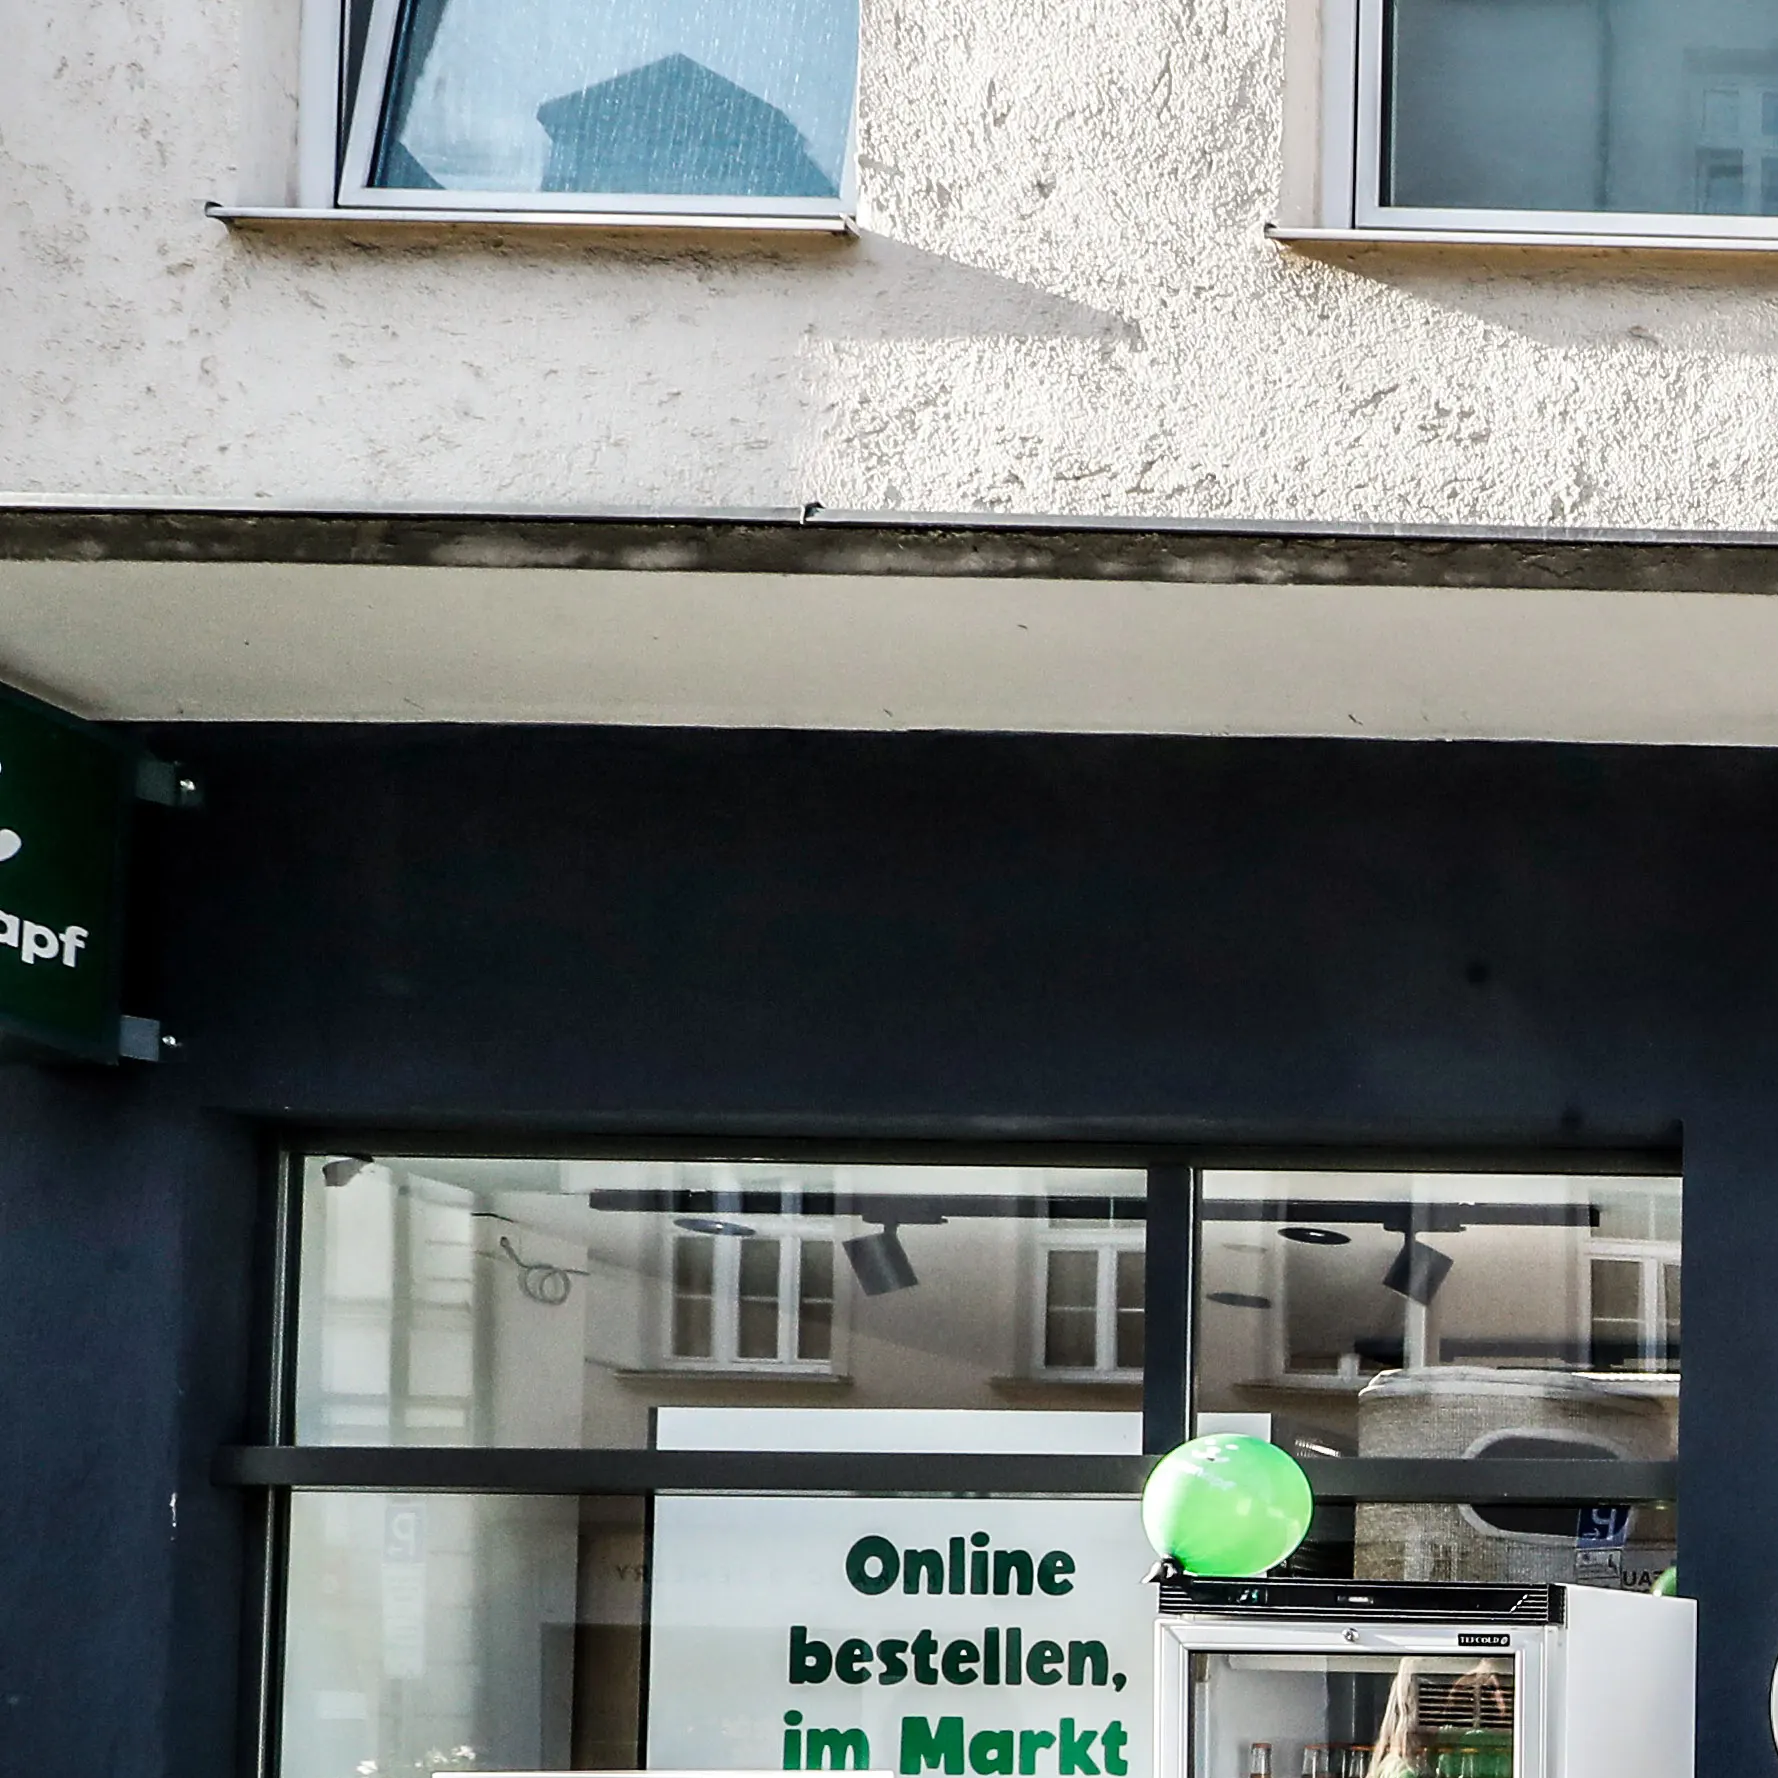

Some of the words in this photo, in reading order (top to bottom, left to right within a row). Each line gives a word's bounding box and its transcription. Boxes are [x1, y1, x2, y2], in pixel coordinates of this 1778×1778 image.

[845, 1531, 1076, 1597] Online
[788, 1626, 1128, 1692] bestellen,
[782, 1710, 871, 1771] im
[899, 1715, 1129, 1777] Markt
